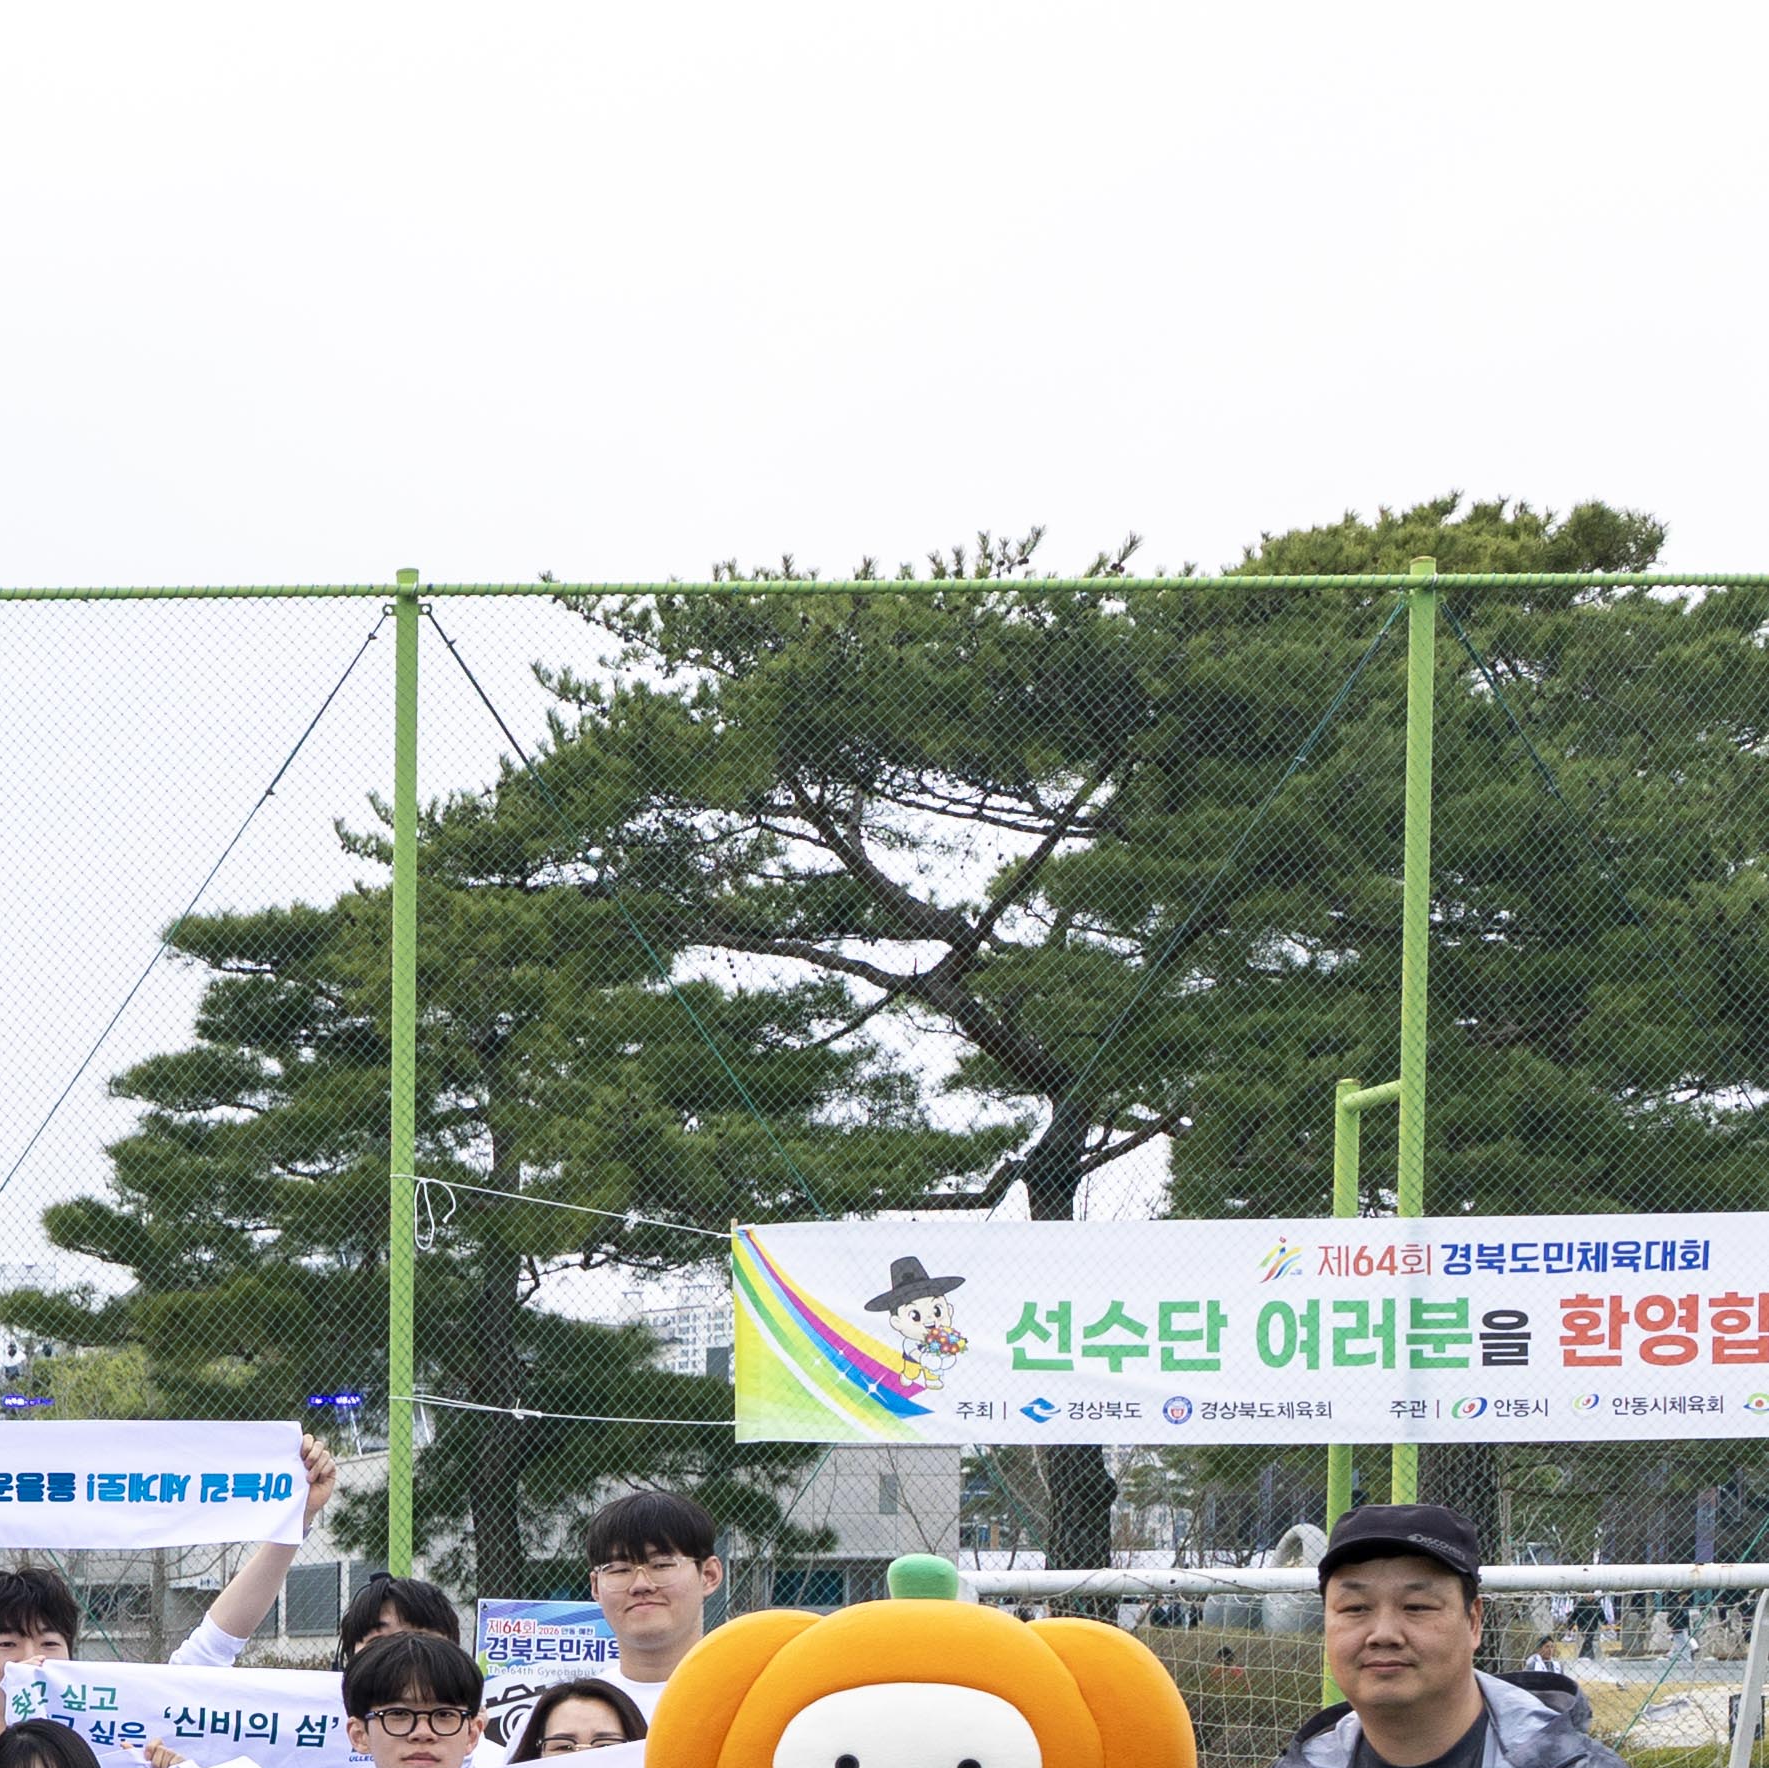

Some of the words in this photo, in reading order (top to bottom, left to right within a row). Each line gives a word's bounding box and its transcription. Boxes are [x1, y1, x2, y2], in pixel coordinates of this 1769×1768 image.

[1315, 1242, 1434, 1279] 제64회
[1440, 1238, 1712, 1277] 경북도민체육대회
[1006, 1299, 1230, 1374] 선수단
[1256, 1295, 1532, 1370] 여러분을
[956, 1402, 993, 1420] 주최
[1067, 1401, 1143, 1420] 경상북도
[1200, 1401, 1333, 1421] 경상북도체육회
[1389, 1400, 1426, 1419] 주관
[1493, 1398, 1549, 1418] 안동시
[1611, 1395, 1725, 1415] 안동시체육회
[87, 1473, 193, 1504] 세계로!
[200, 1473, 294, 1505] 하늘길
[487, 1619, 536, 1634] 제64회
[538, 1626, 560, 1635] 2026
[488, 1666, 510, 1675] The
[510, 1666, 534, 1675] 64th
[61, 1686, 119, 1713] 싶고
[86, 1721, 148, 1751] 싶은
